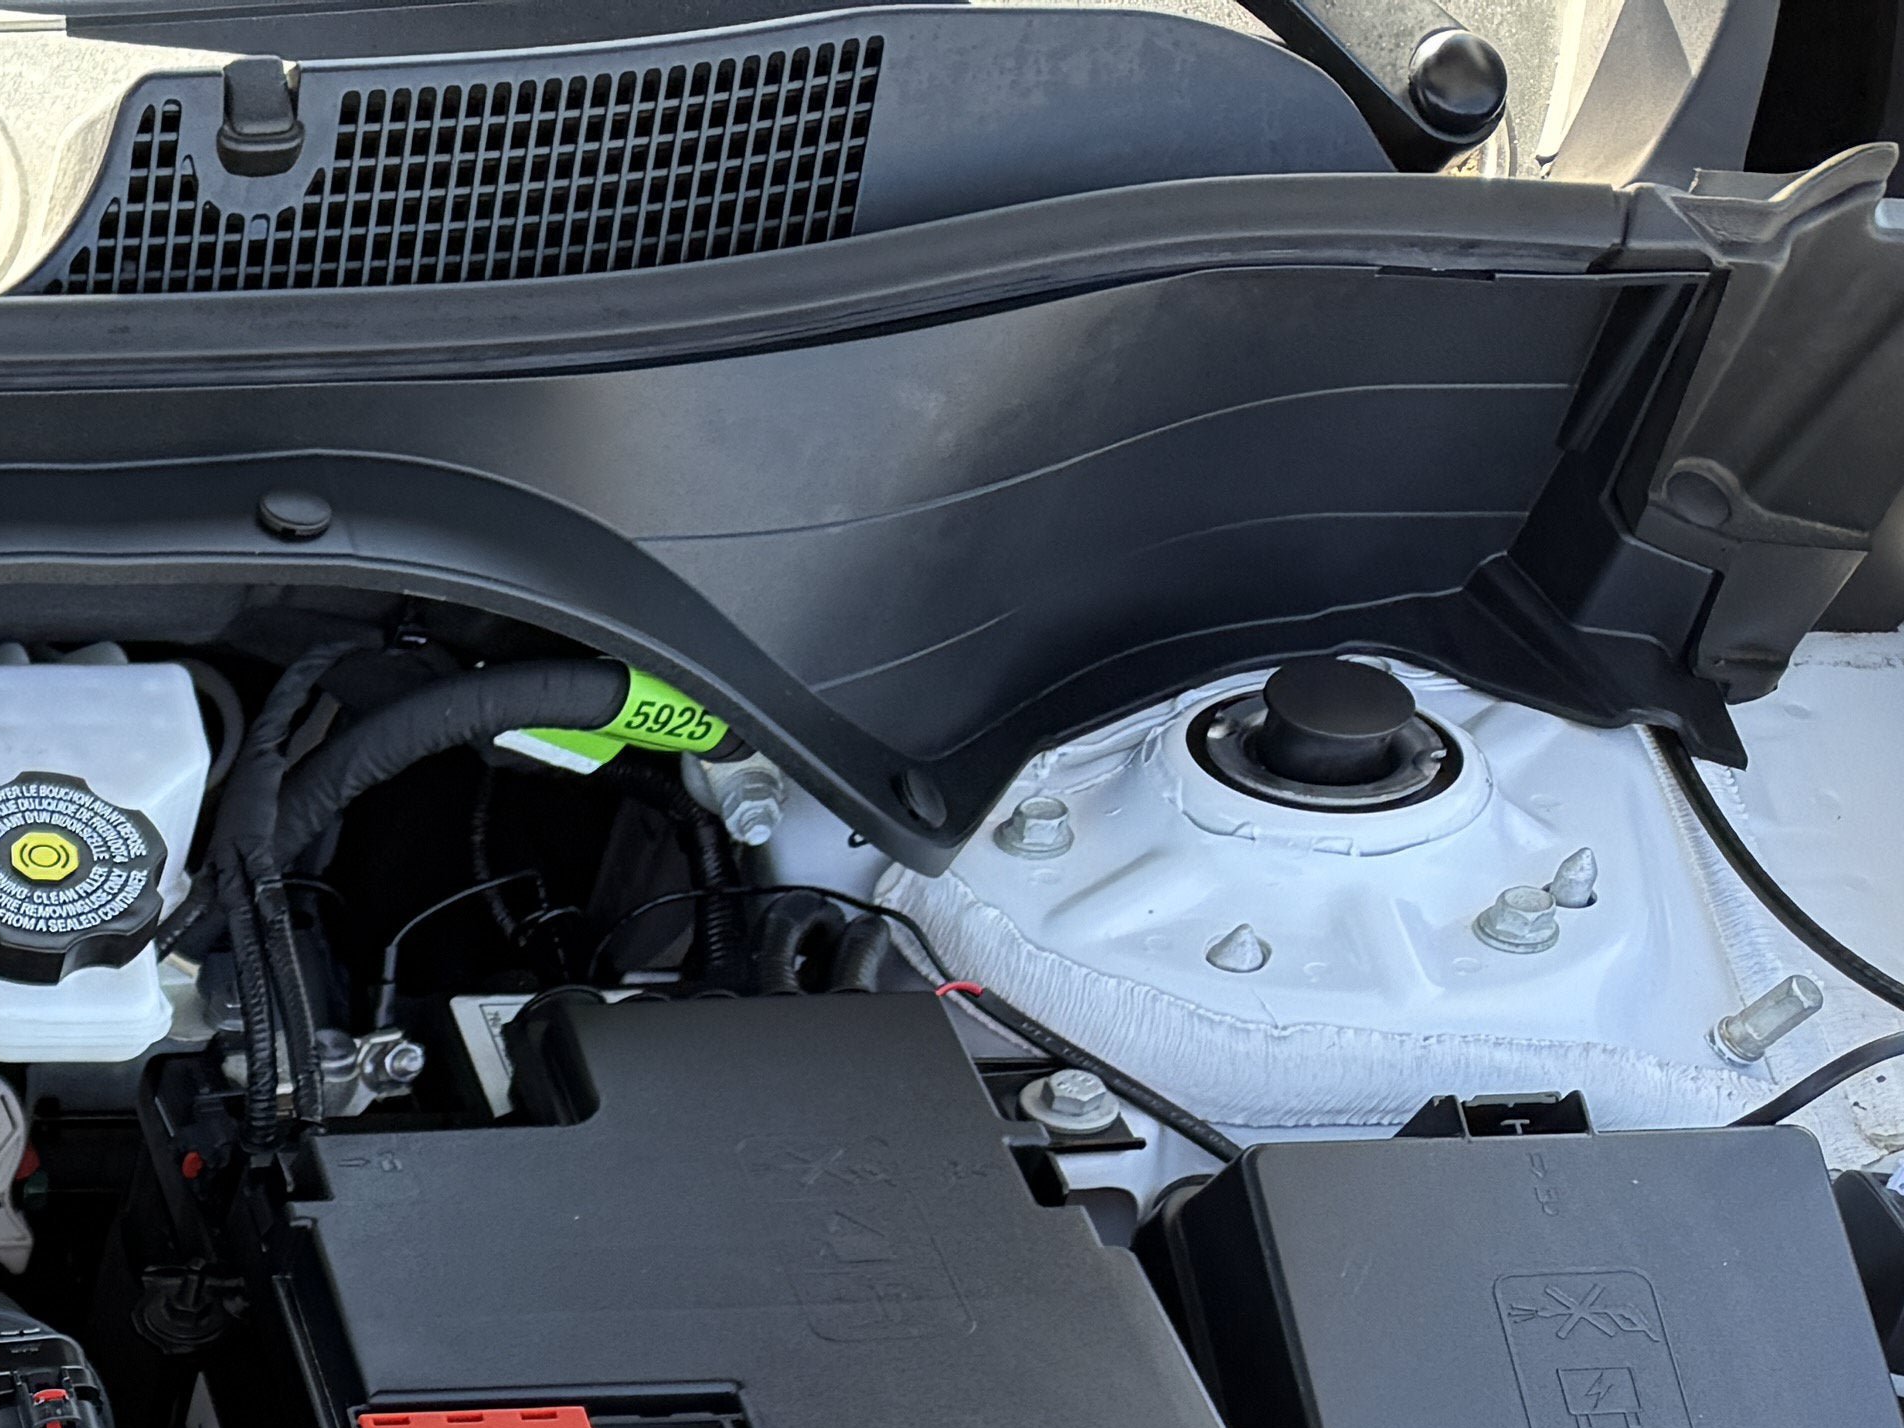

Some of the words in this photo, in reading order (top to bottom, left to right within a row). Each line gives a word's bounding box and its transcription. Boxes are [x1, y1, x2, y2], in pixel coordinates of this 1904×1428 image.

[624, 699, 713, 741] 5925
[18, 798, 35, 811] DU
[76, 807, 94, 823] DE
[22, 784, 38, 797] LE
[39, 784, 95, 808] BOUCHON
[90, 800, 122, 826] AVANT
[33, 887, 79, 905] CLEAN
[75, 864, 109, 897] FILLER
[35, 920, 47, 933] A
[48, 912, 102, 933] SEALED
